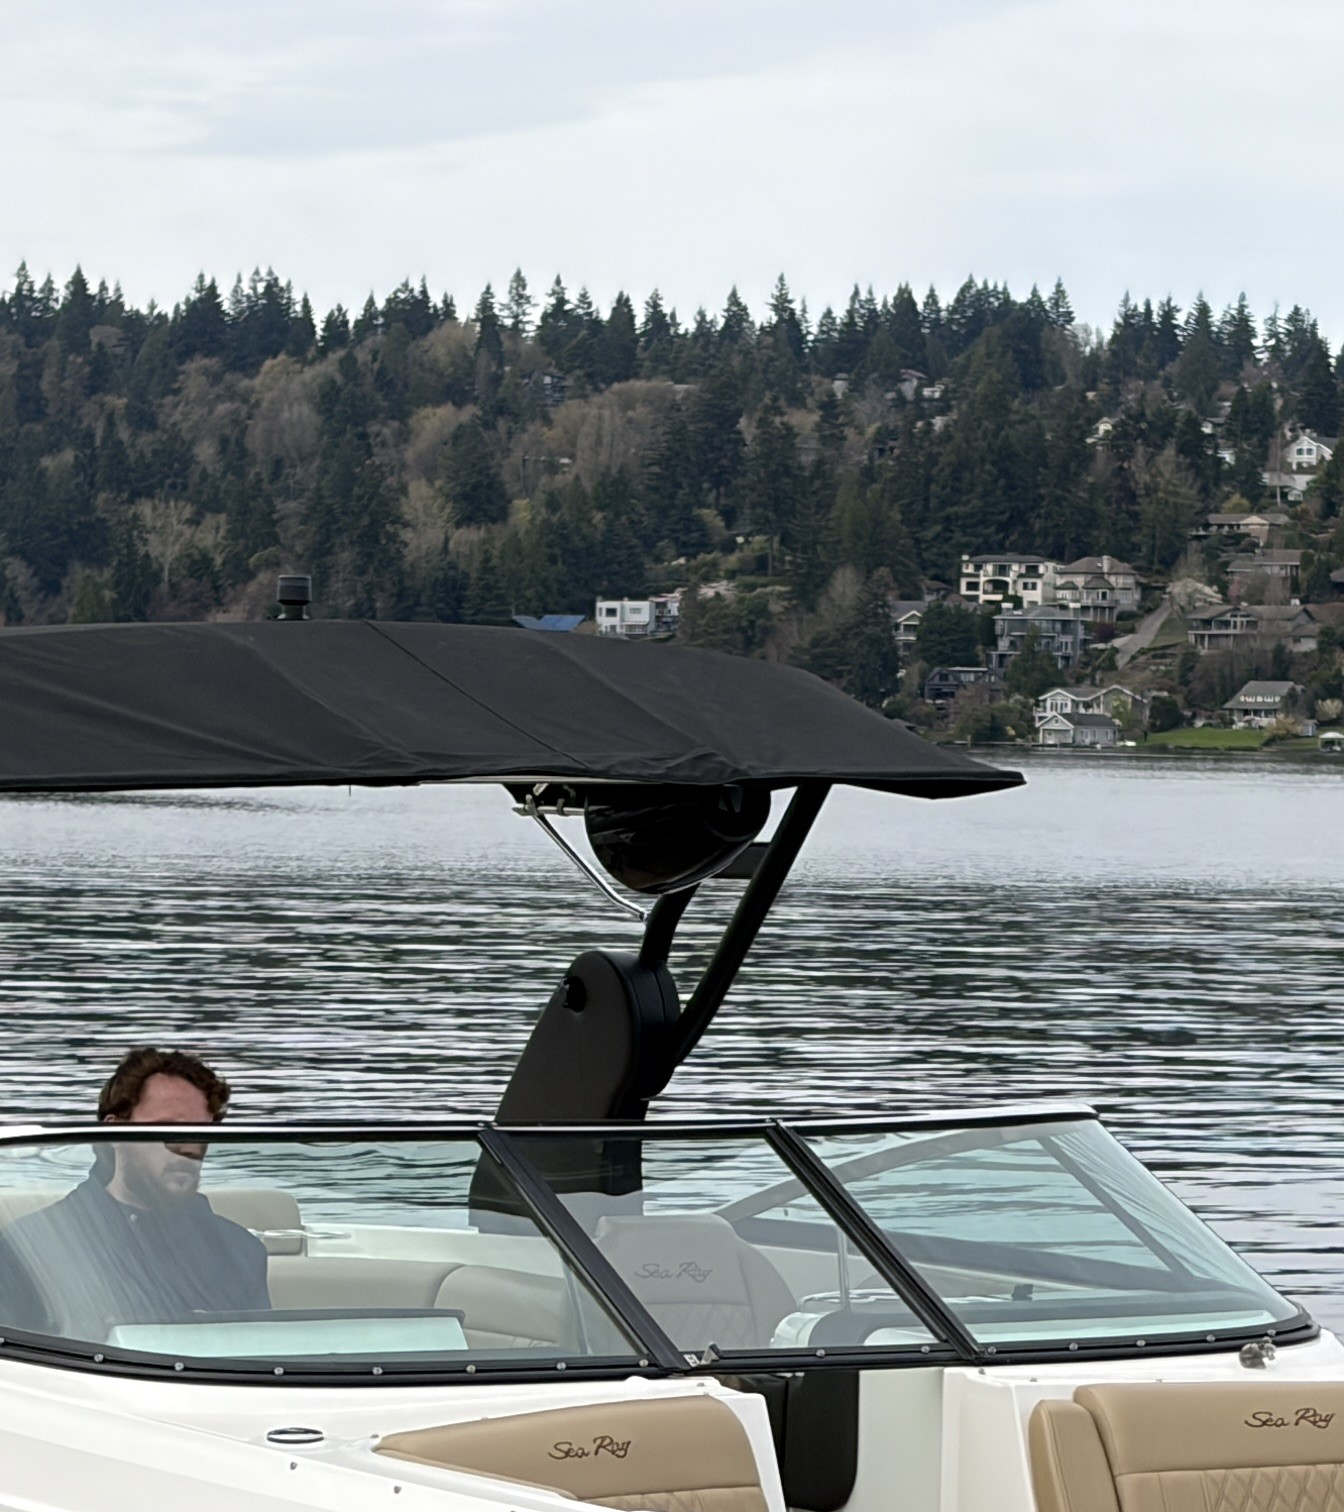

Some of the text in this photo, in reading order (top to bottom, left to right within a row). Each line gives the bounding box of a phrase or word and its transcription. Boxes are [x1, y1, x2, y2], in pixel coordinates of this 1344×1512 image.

[634, 1261, 713, 1283] Sea Ray
[1244, 1407, 1336, 1429] Sea Ray
[548, 1435, 632, 1460] Sea Ray
